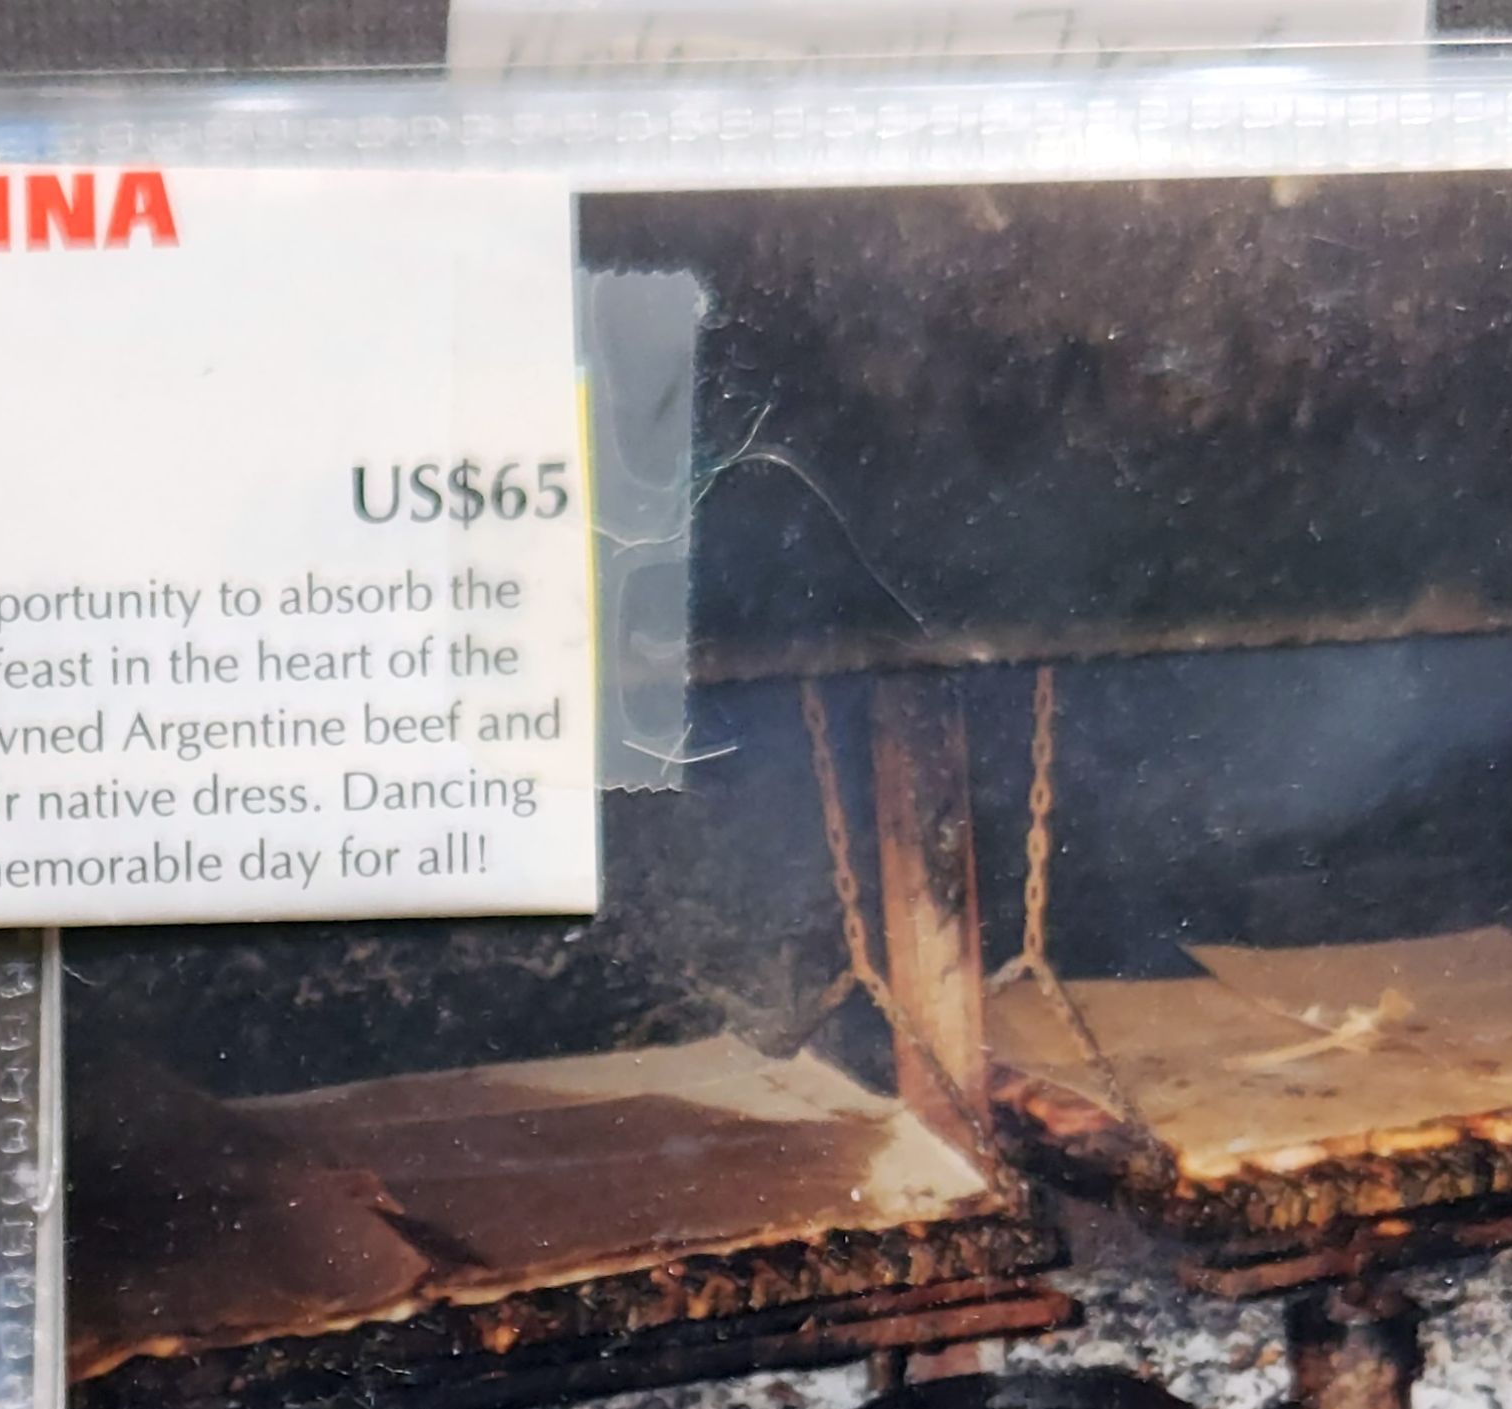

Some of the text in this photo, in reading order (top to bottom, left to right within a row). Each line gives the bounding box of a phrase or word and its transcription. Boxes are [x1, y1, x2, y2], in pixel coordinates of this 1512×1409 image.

[352, 457, 568, 530] US$65
[219, 582, 262, 616] to
[280, 569, 432, 615] absorb
[450, 567, 521, 610] the
[112, 646, 149, 685] in
[169, 641, 238, 684] the
[258, 639, 371, 681] heart
[389, 635, 434, 677] of
[448, 633, 519, 676] the
[123, 708, 345, 761] Argentine
[364, 700, 462, 744] beef
[478, 697, 560, 741] and
[39, 779, 175, 820] native
[193, 773, 320, 815] dress.
[343, 768, 537, 817] Dancing
[240, 838, 321, 888] day
[340, 835, 400, 876] for
[418, 832, 485, 875] all!
